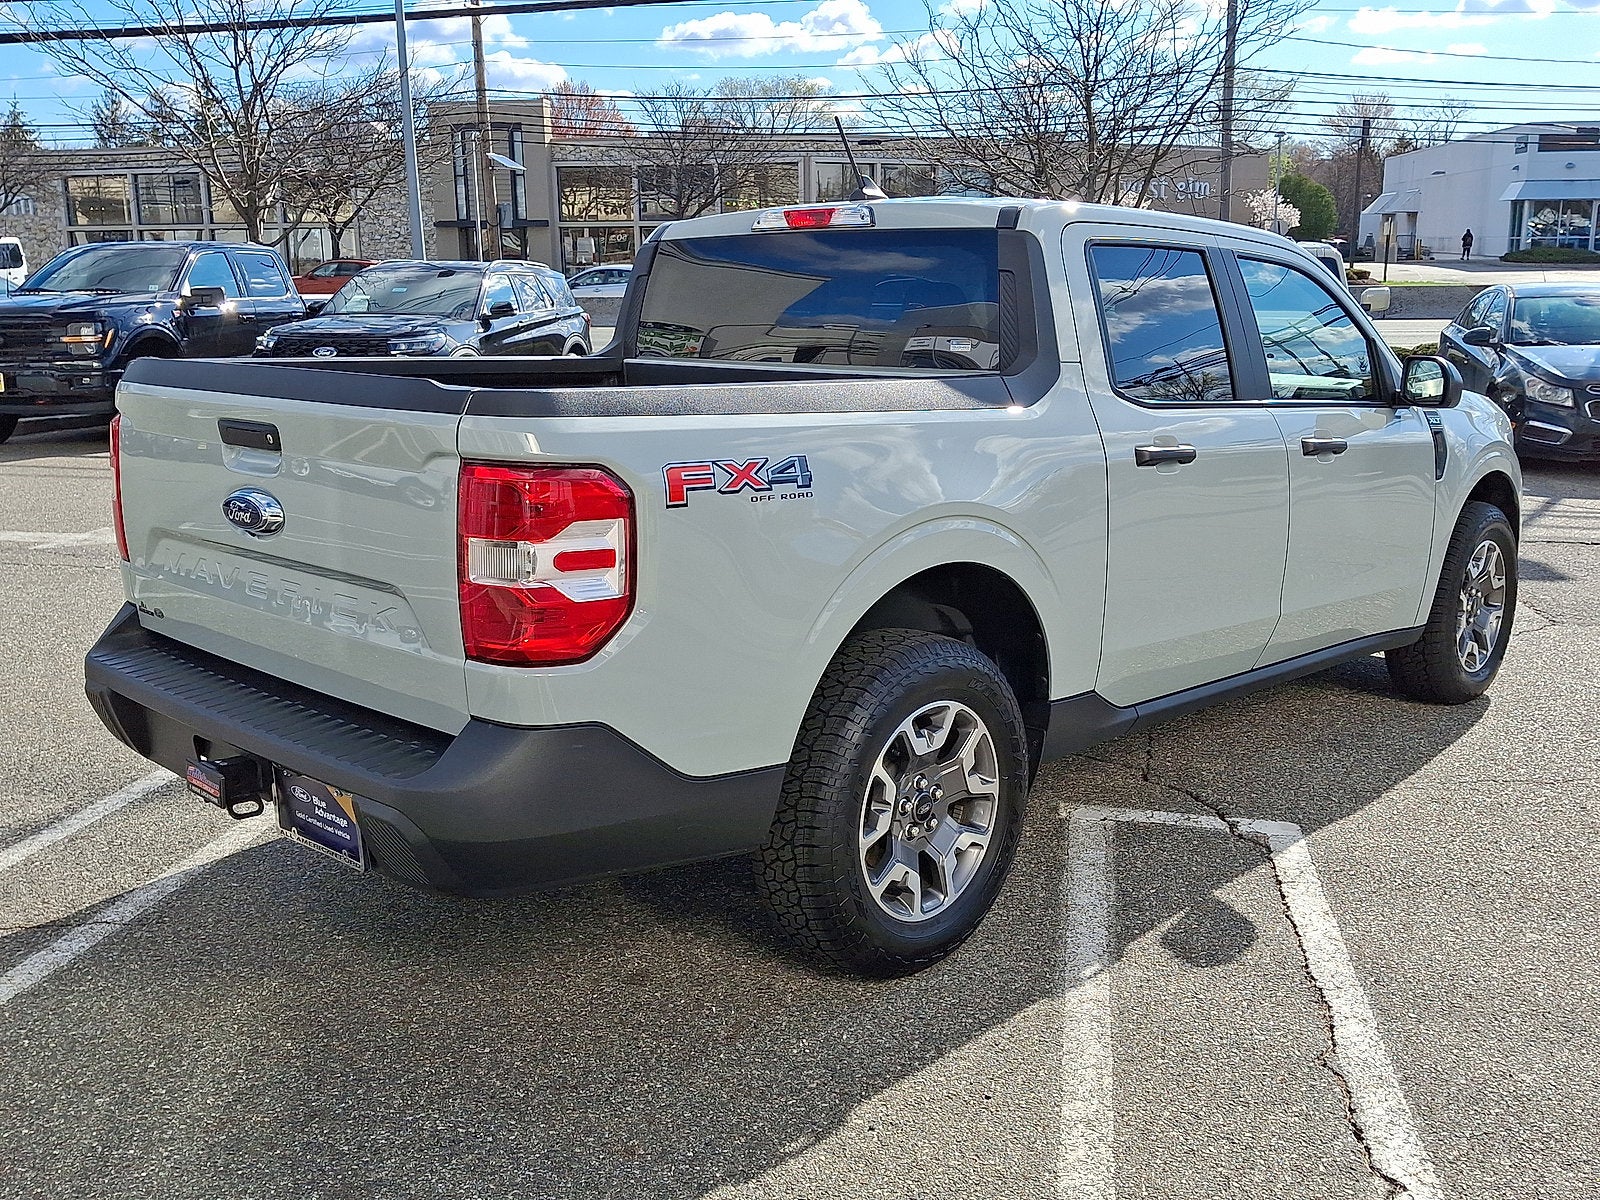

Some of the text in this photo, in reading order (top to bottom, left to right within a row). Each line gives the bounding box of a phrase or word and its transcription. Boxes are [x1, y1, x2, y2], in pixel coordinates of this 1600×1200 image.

[1119, 177, 1169, 200] wst
[662, 454, 813, 509] FX4
[750, 491, 814, 503] OFF ROAD
[228, 500, 252, 523] Ford
[163, 547, 399, 634] MAVERICK
[312, 796, 327, 809] Blue
[295, 810, 306, 820] Gold
[305, 814, 323, 828] Certified
[323, 823, 334, 834] Used
[314, 807, 348, 828] Advantage
